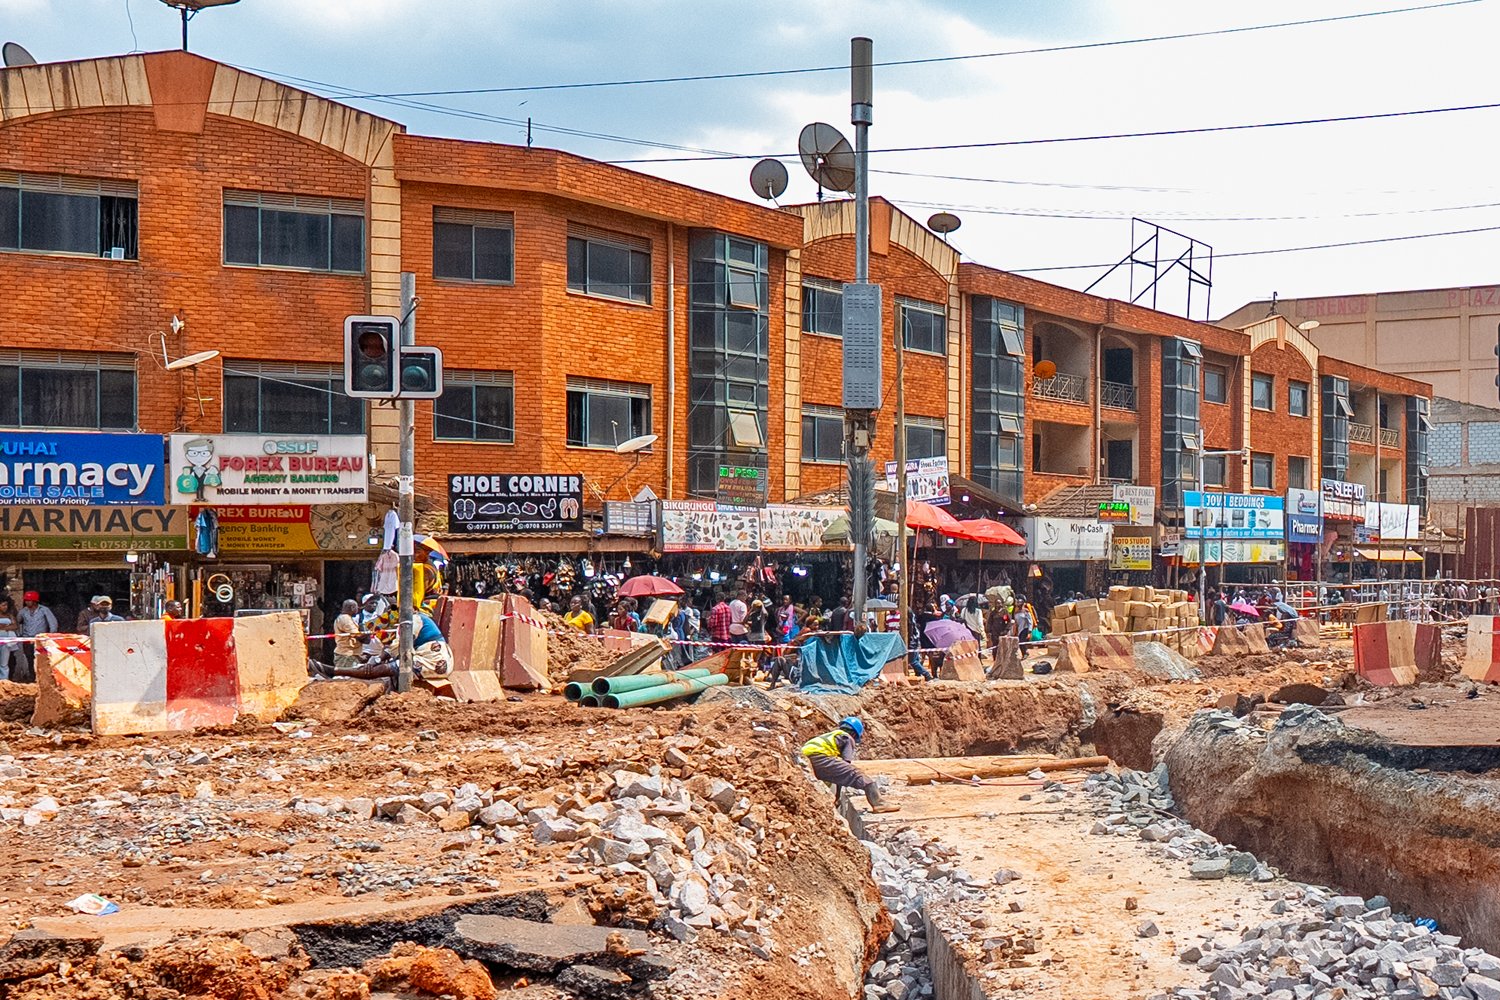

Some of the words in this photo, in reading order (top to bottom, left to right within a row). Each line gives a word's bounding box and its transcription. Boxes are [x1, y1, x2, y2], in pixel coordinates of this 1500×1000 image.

[218, 456, 284, 472] FOREX
[289, 456, 364, 472] BUREAU
[244, 474, 288, 484] AGENCY
[290, 474, 340, 484] BANKING
[452, 475, 501, 493] SHOE
[508, 475, 580, 493] CORNER
[46, 486, 105, 498] SALE
[216, 487, 249, 495] MOBILE
[251, 487, 281, 495] MONEY
[291, 487, 322, 495] MONEY
[323, 487, 365, 495] TRANSFER
[1125, 487, 1138, 496] BEST
[1138, 487, 1155, 497] FOREX
[1333, 481, 1365, 499] SLEELO
[14, 497, 42, 505] Health
[663, 501, 714, 511] BIKURUNGU
[1229, 496, 1265, 509] BEDDINGS
[212, 507, 245, 518] REX
[248, 508, 304, 518] BUREAU
[219, 525, 248, 535] gency
[250, 524, 289, 535] Banking
[1070, 523, 1104, 535] Klyn-Cash
[100, 540, 128, 549] 0758
[155, 540, 175, 549] 515
